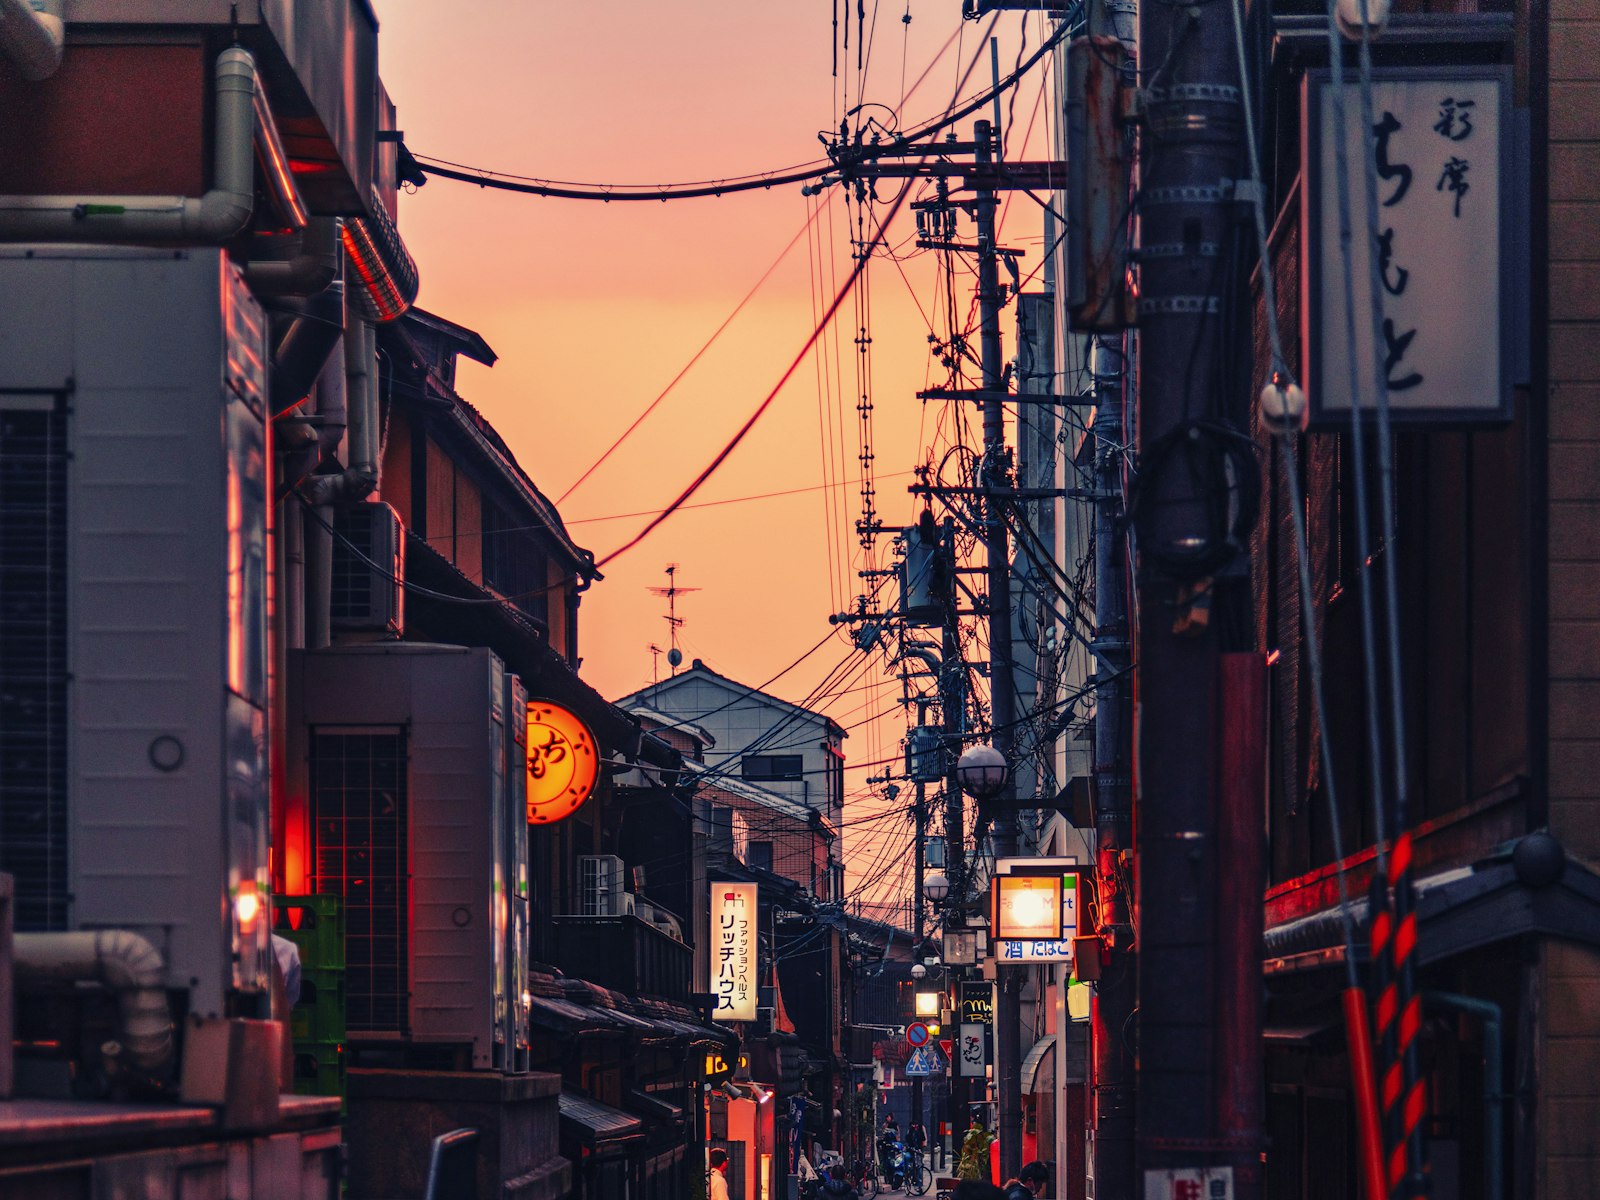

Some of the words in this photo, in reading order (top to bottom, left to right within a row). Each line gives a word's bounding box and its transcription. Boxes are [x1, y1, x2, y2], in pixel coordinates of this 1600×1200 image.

[1373, 111, 1423, 391] ちもと
[719, 914, 735, 1010] リッチハウス
[738, 920, 748, 1001] ファッションヘルス
[1004, 940, 1023, 959] 酒
